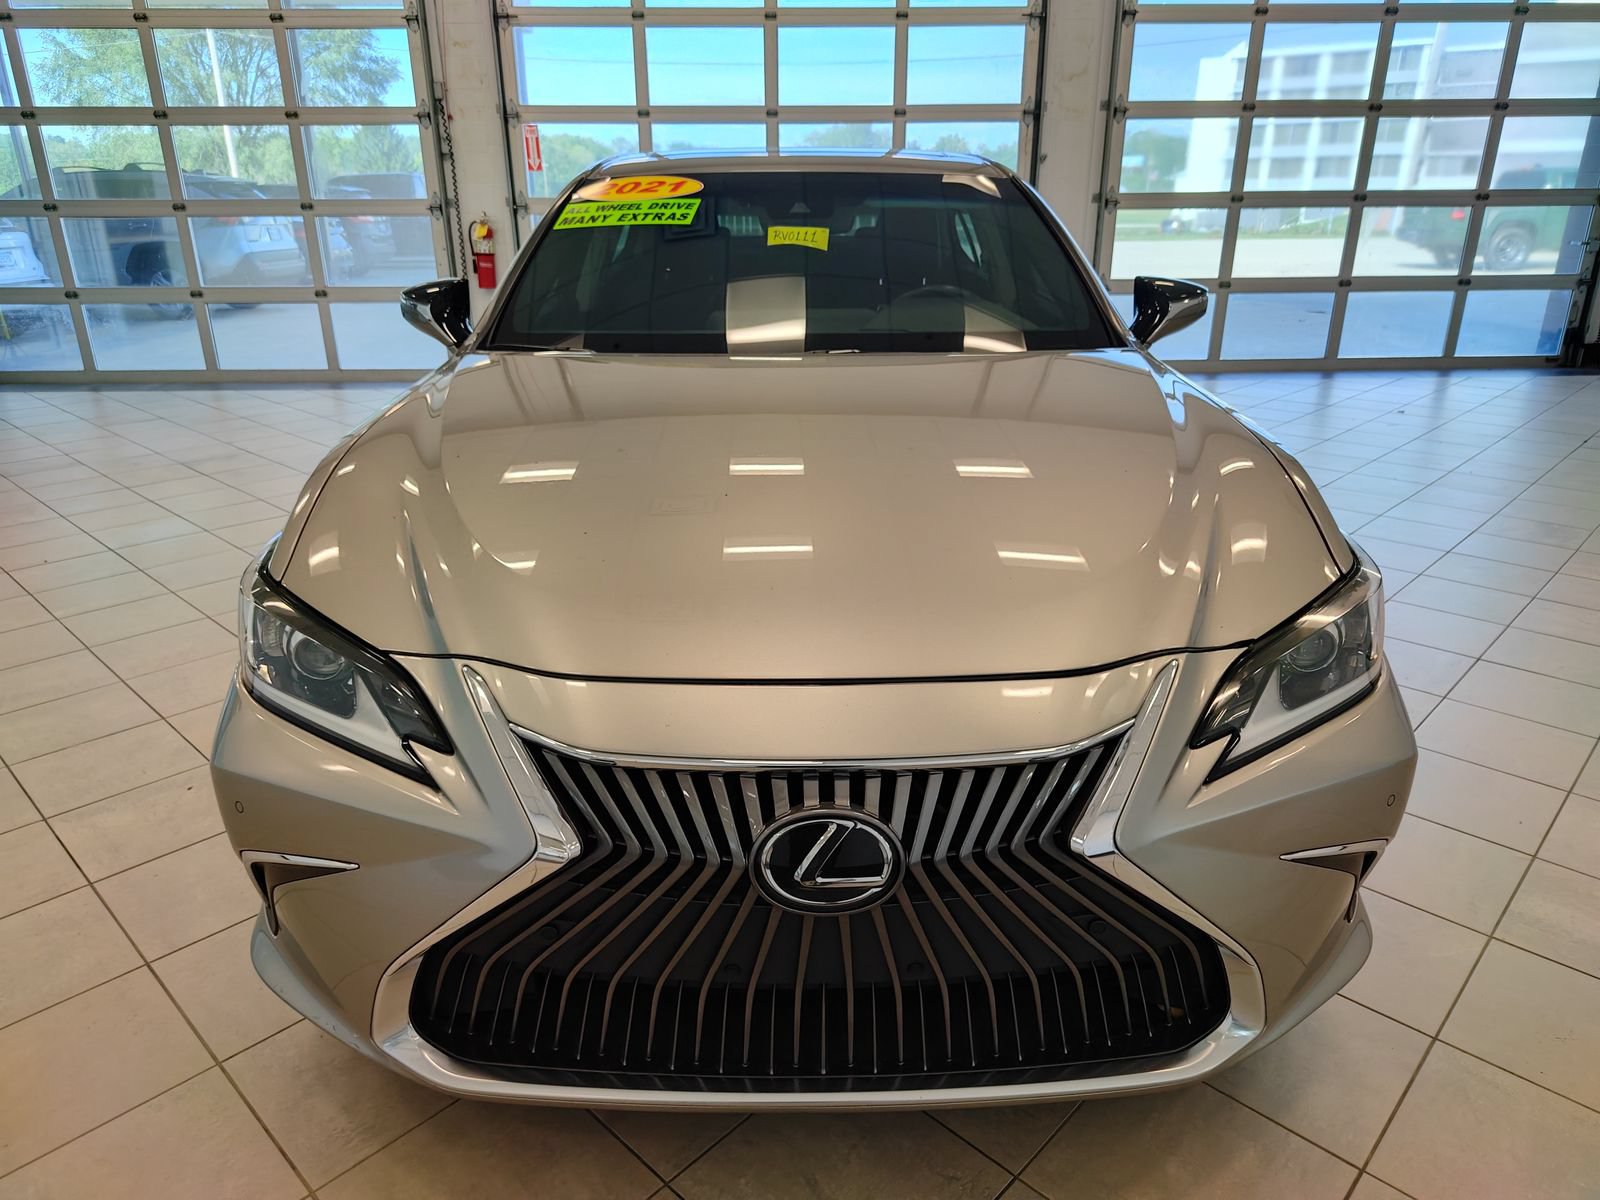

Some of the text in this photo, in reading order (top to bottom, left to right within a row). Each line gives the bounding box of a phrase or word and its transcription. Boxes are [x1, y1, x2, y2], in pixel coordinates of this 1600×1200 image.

[599, 181, 688, 196] 2021
[596, 203, 643, 213] WHEEL
[647, 202, 697, 210] DRIVE
[558, 212, 691, 226] MANY EXTRAS
